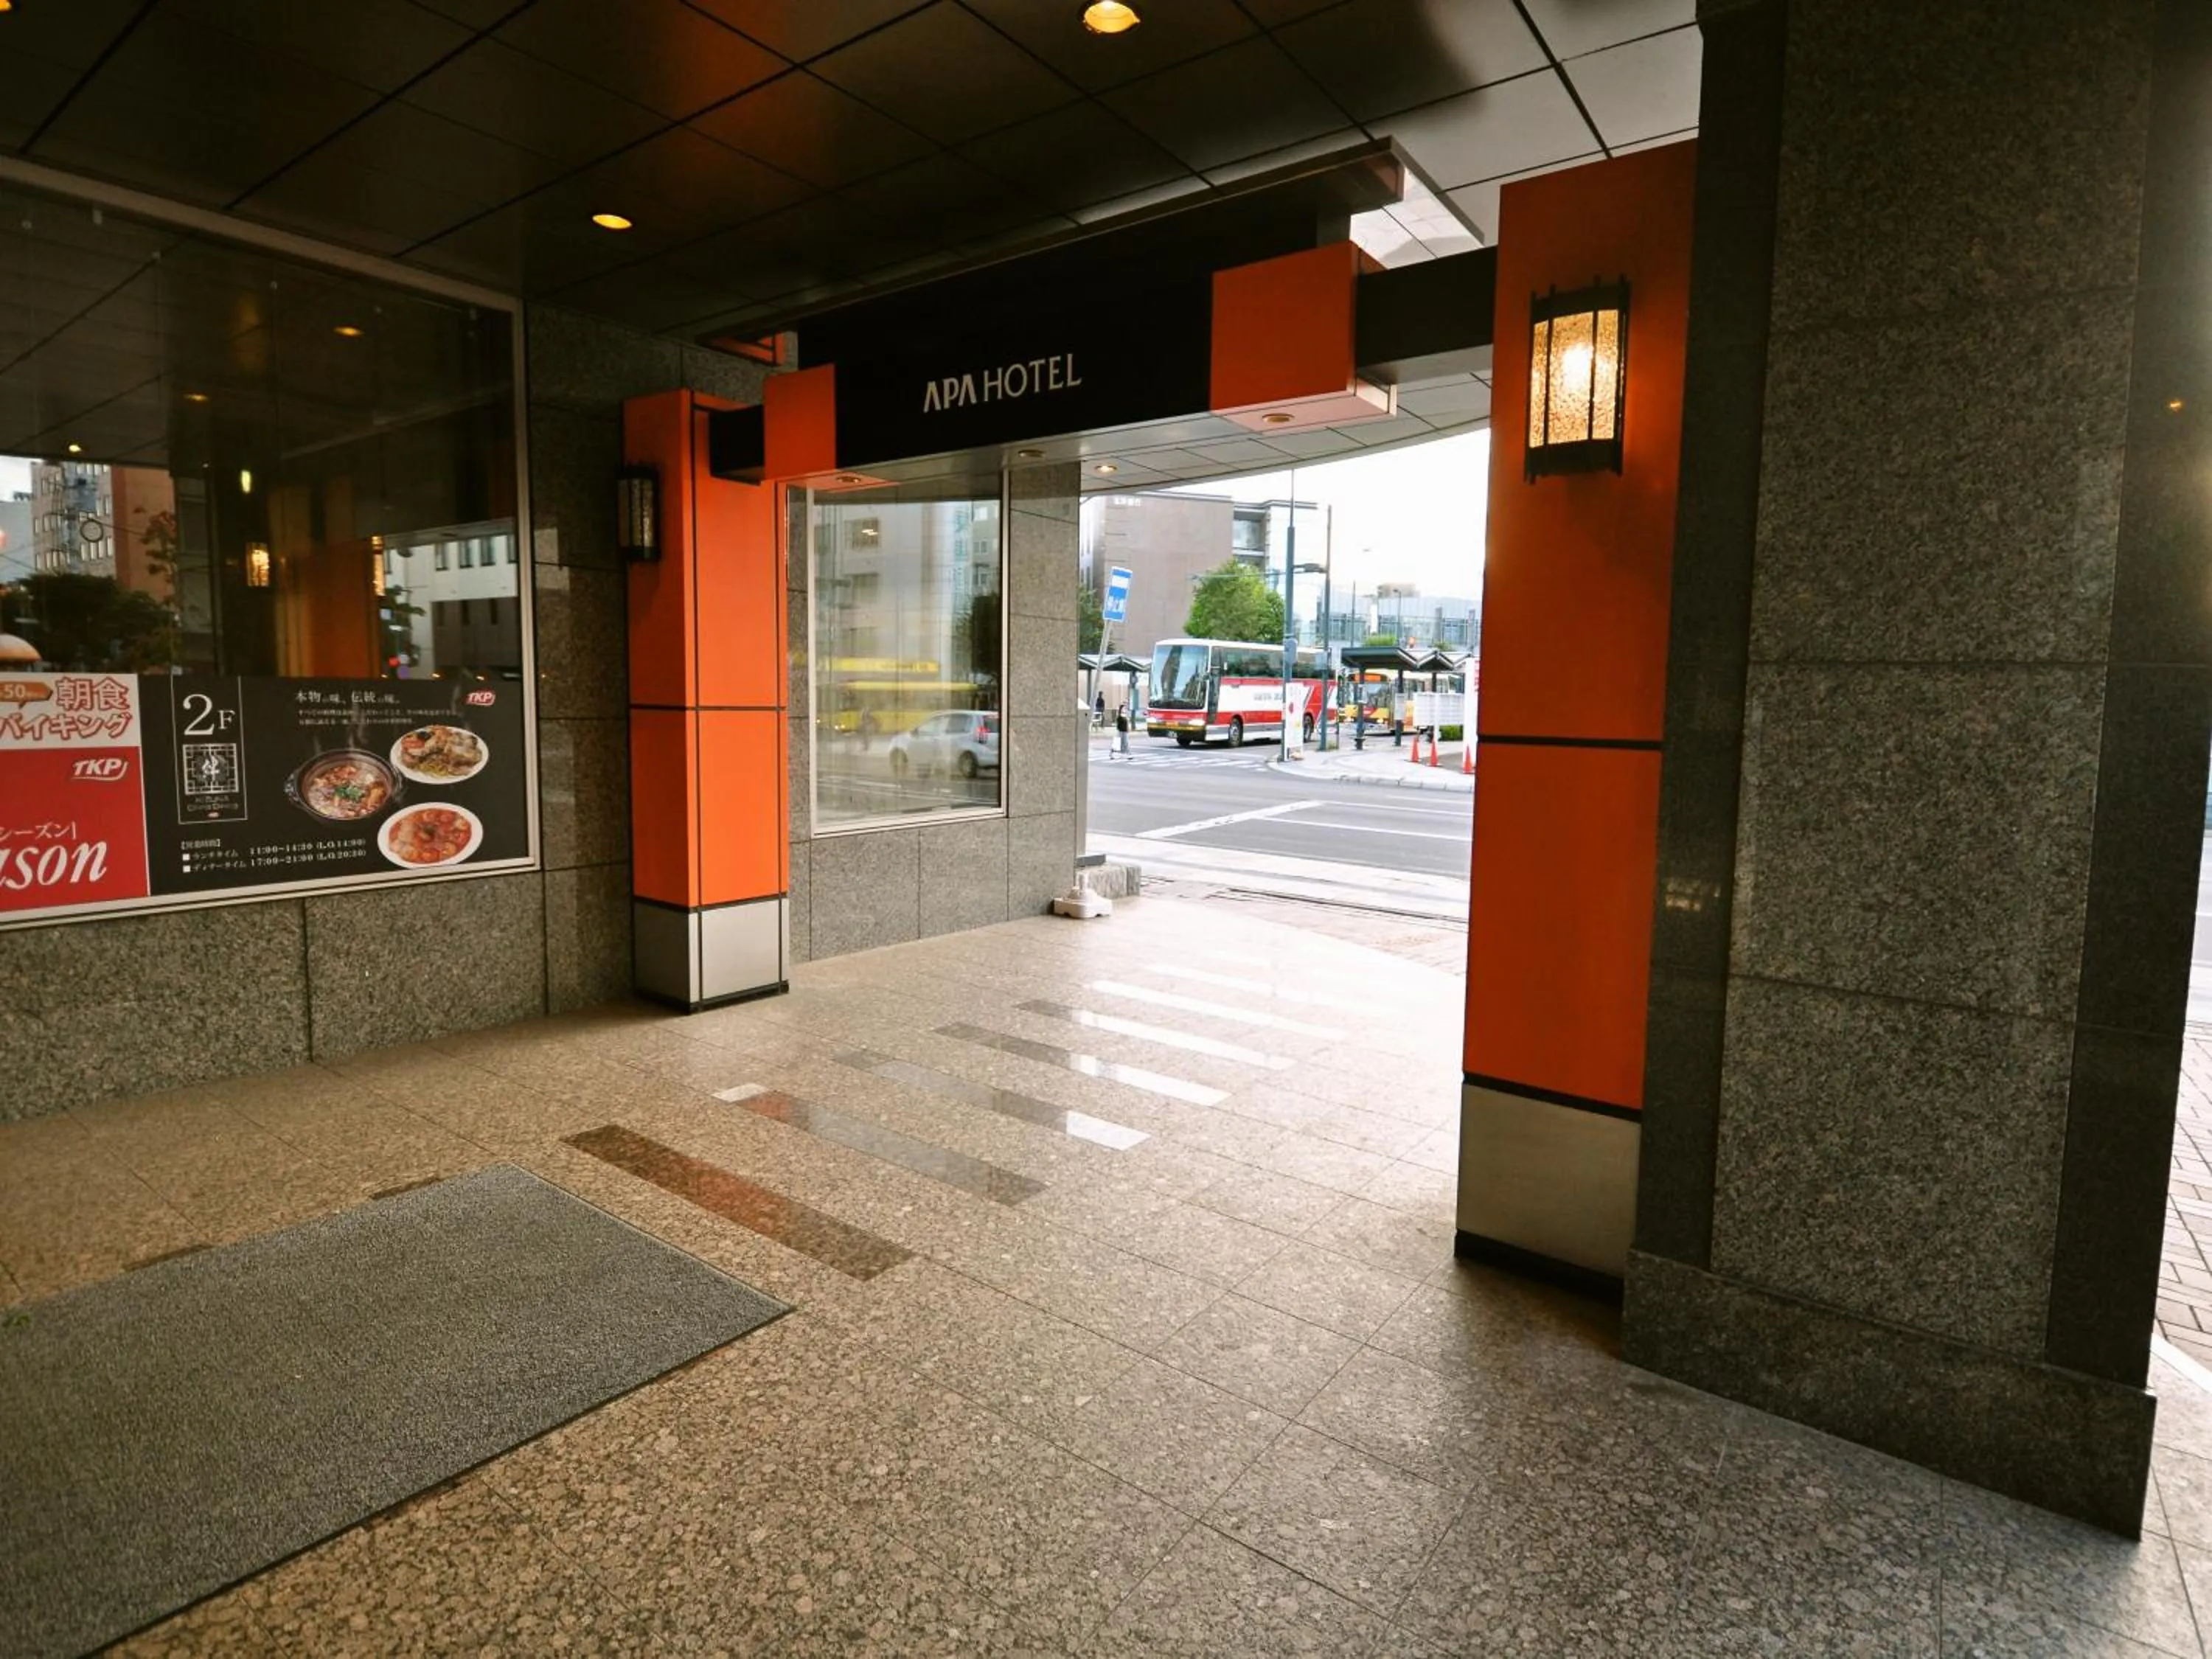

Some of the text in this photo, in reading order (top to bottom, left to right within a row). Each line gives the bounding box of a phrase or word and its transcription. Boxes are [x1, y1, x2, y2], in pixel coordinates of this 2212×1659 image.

[923, 353, 1082, 413] APA HOTEL
[55, 675, 131, 711] 朝食
[466, 692, 496, 706] TKP
[0, 712, 133, 741] バイキング
[72, 758, 128, 779] TKP
